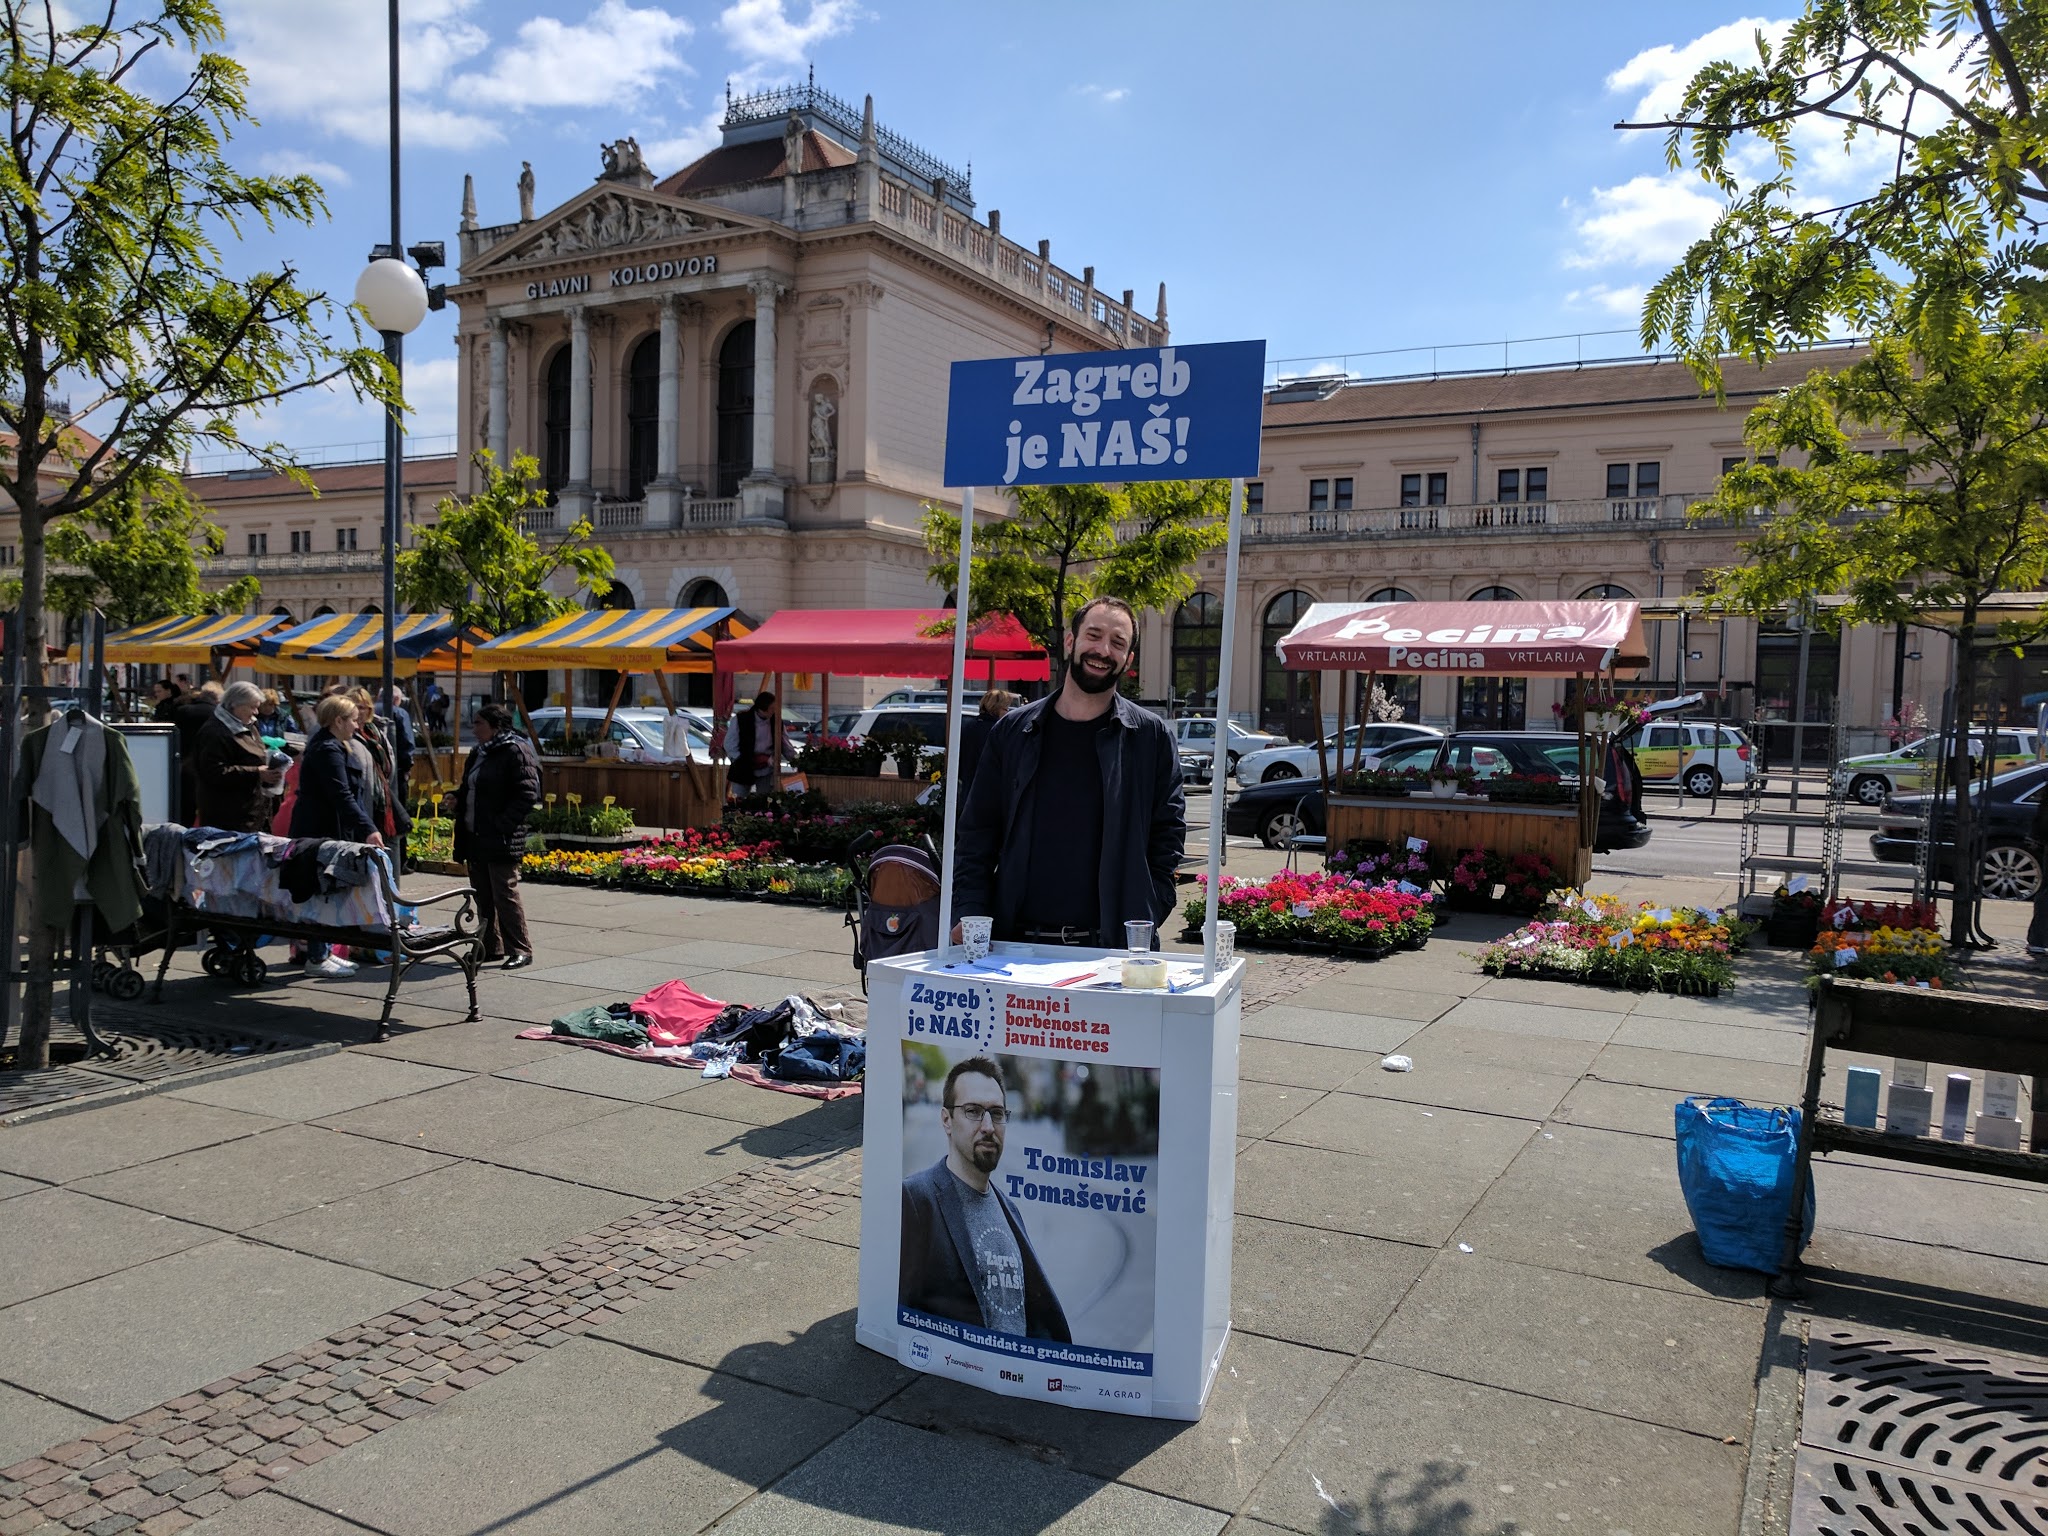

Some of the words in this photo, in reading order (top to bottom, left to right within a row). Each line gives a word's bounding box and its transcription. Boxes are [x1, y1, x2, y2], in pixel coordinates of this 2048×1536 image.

[526, 275, 589, 299] GLAVNI
[608, 255, 717, 287] KOLODVOR
[1013, 348, 1190, 416] Zagreb
[1002, 420, 1048, 485] je
[1058, 402, 1190, 468] NAŠ!
[1298, 651, 1367, 662] VRTLARIJA
[1508, 652, 1586, 663] VRTLARIJA
[910, 983, 980, 1012] Zagreb
[1006, 994, 1061, 1016] Znanje
[1064, 997, 1070, 1013] i
[908, 1009, 925, 1036] je
[929, 1012, 980, 1039] NAŠ!
[1005, 1011, 1088, 1033] borbenost
[1091, 1022, 1110, 1035] za
[1005, 1028, 1046, 1047] javni
[1049, 1033, 1109, 1053] interes
[1023, 1147, 1147, 1183] Tomislav
[1006, 1174, 1146, 1214] Tomašević
[984, 1251, 1018, 1272] Zagreb
[987, 1270, 998, 1290] je
[902, 1312, 959, 1337] Zajednički
[963, 1328, 1018, 1352] kandidat
[1020, 1345, 1036, 1355] za
[1037, 1346, 1144, 1371] gradonačelnika
[912, 1341, 929, 1352] Zagreb
[1049, 1381, 1061, 1390] RF
[1099, 1388, 1111, 1397] ZA
[1114, 1390, 1141, 1399] GRAD
